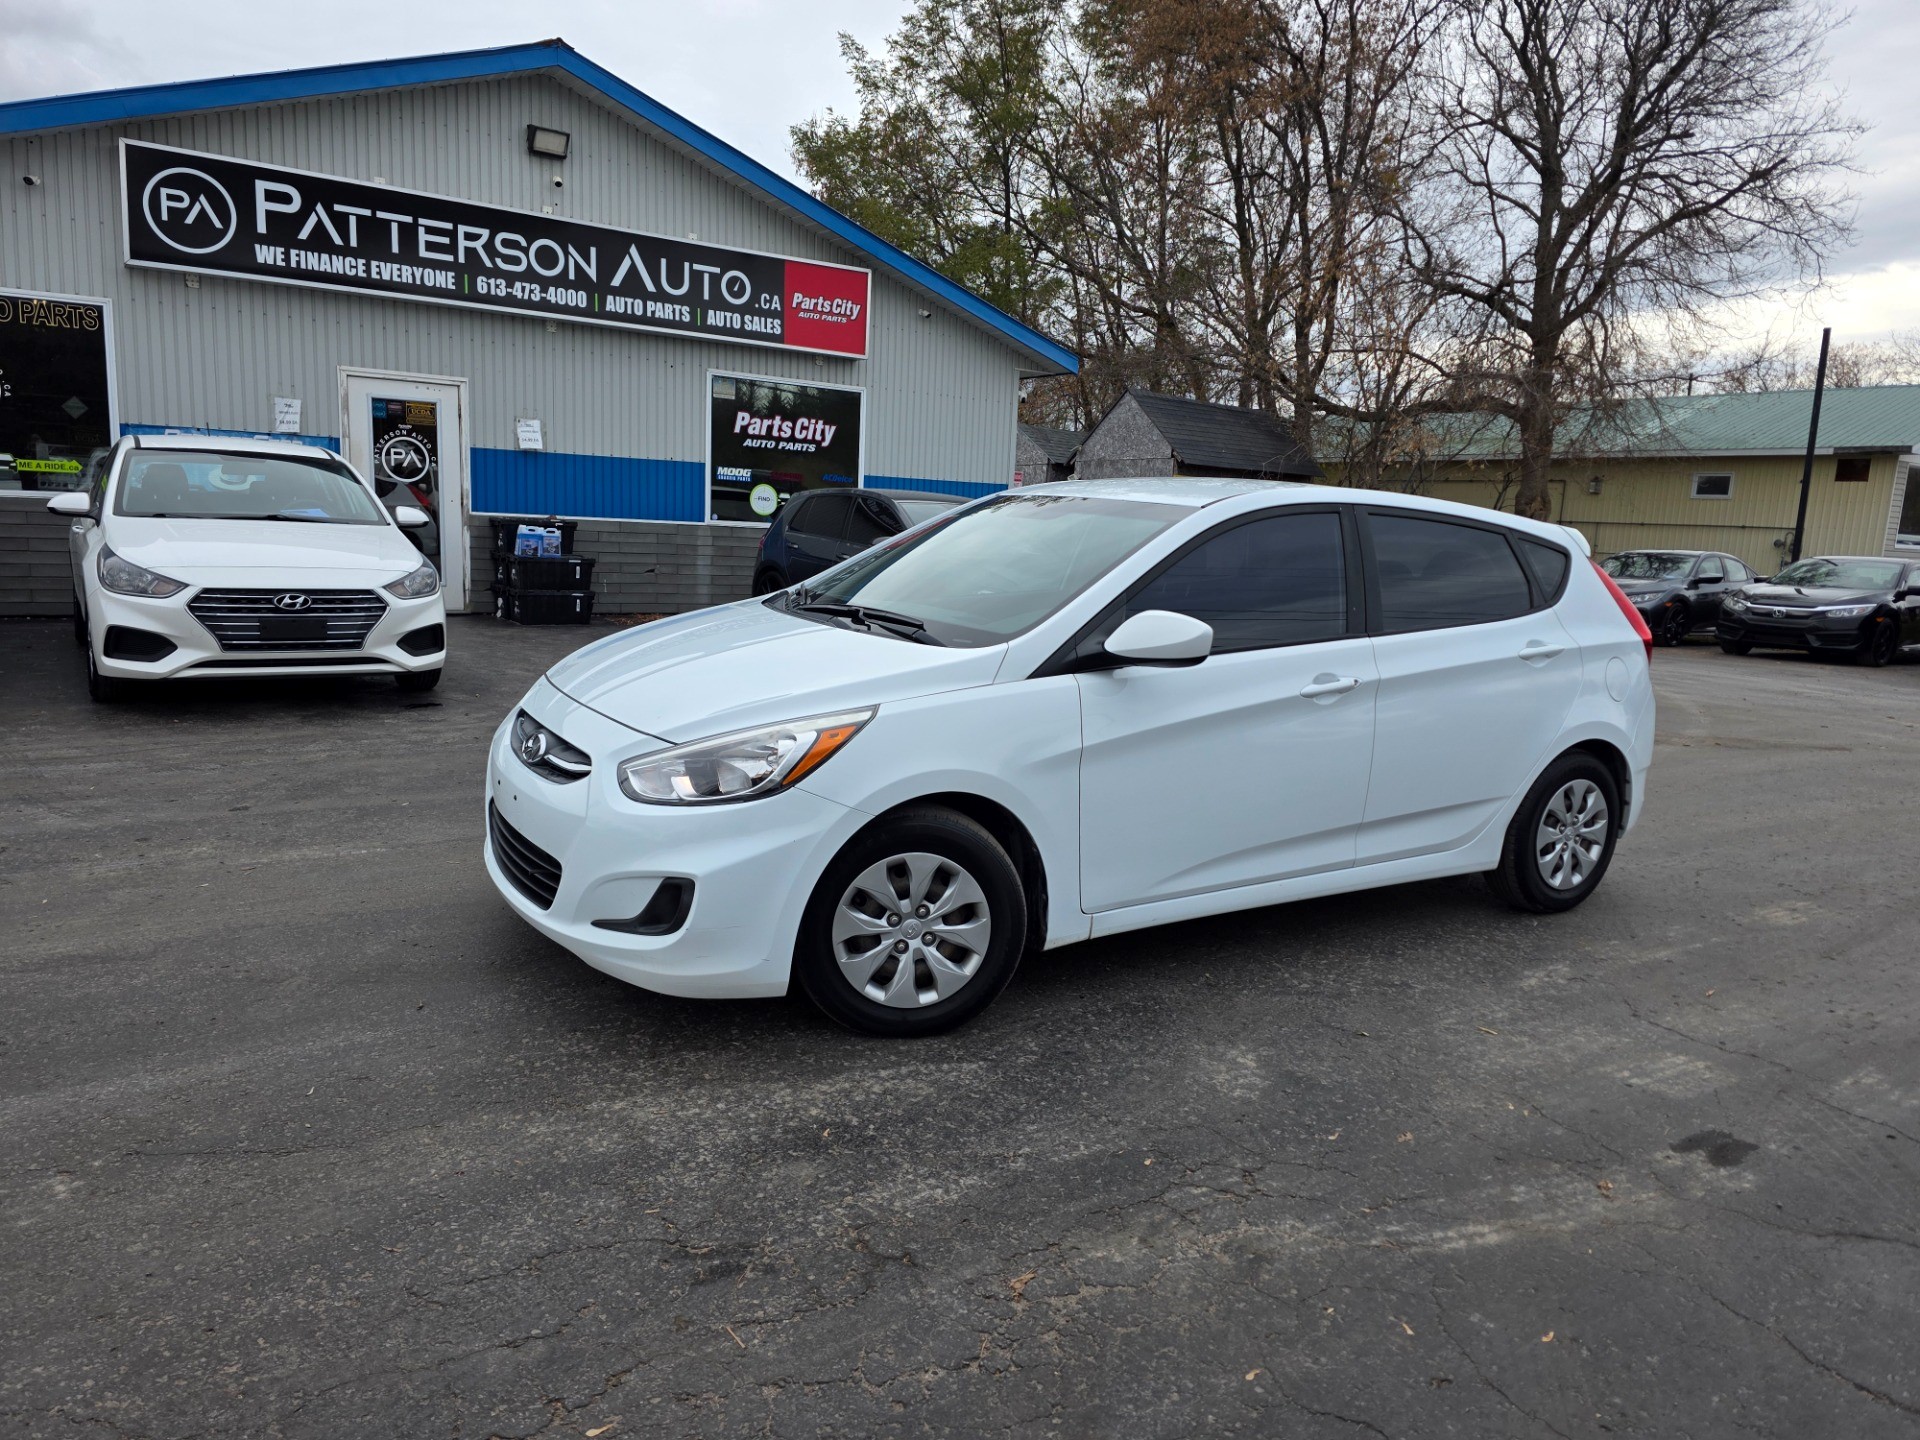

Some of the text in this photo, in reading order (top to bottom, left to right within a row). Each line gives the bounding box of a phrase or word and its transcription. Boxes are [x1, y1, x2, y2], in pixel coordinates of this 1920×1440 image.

[159, 186, 224, 230] PA
[254, 179, 597, 284] PATTERSON
[254, 243, 782, 335] WE FINANCE EVERYONE 613-473-4000 AUTO PARTS AUTO SALES
[18, 299, 100, 331] PARTS
[798, 311, 848, 324] AUTO PARTS
[374, 429, 407, 464] PATTERSON
[390, 447, 423, 468] PA
[743, 438, 816, 452] AUTO PARTS
[717, 466, 752, 477] MOOG
